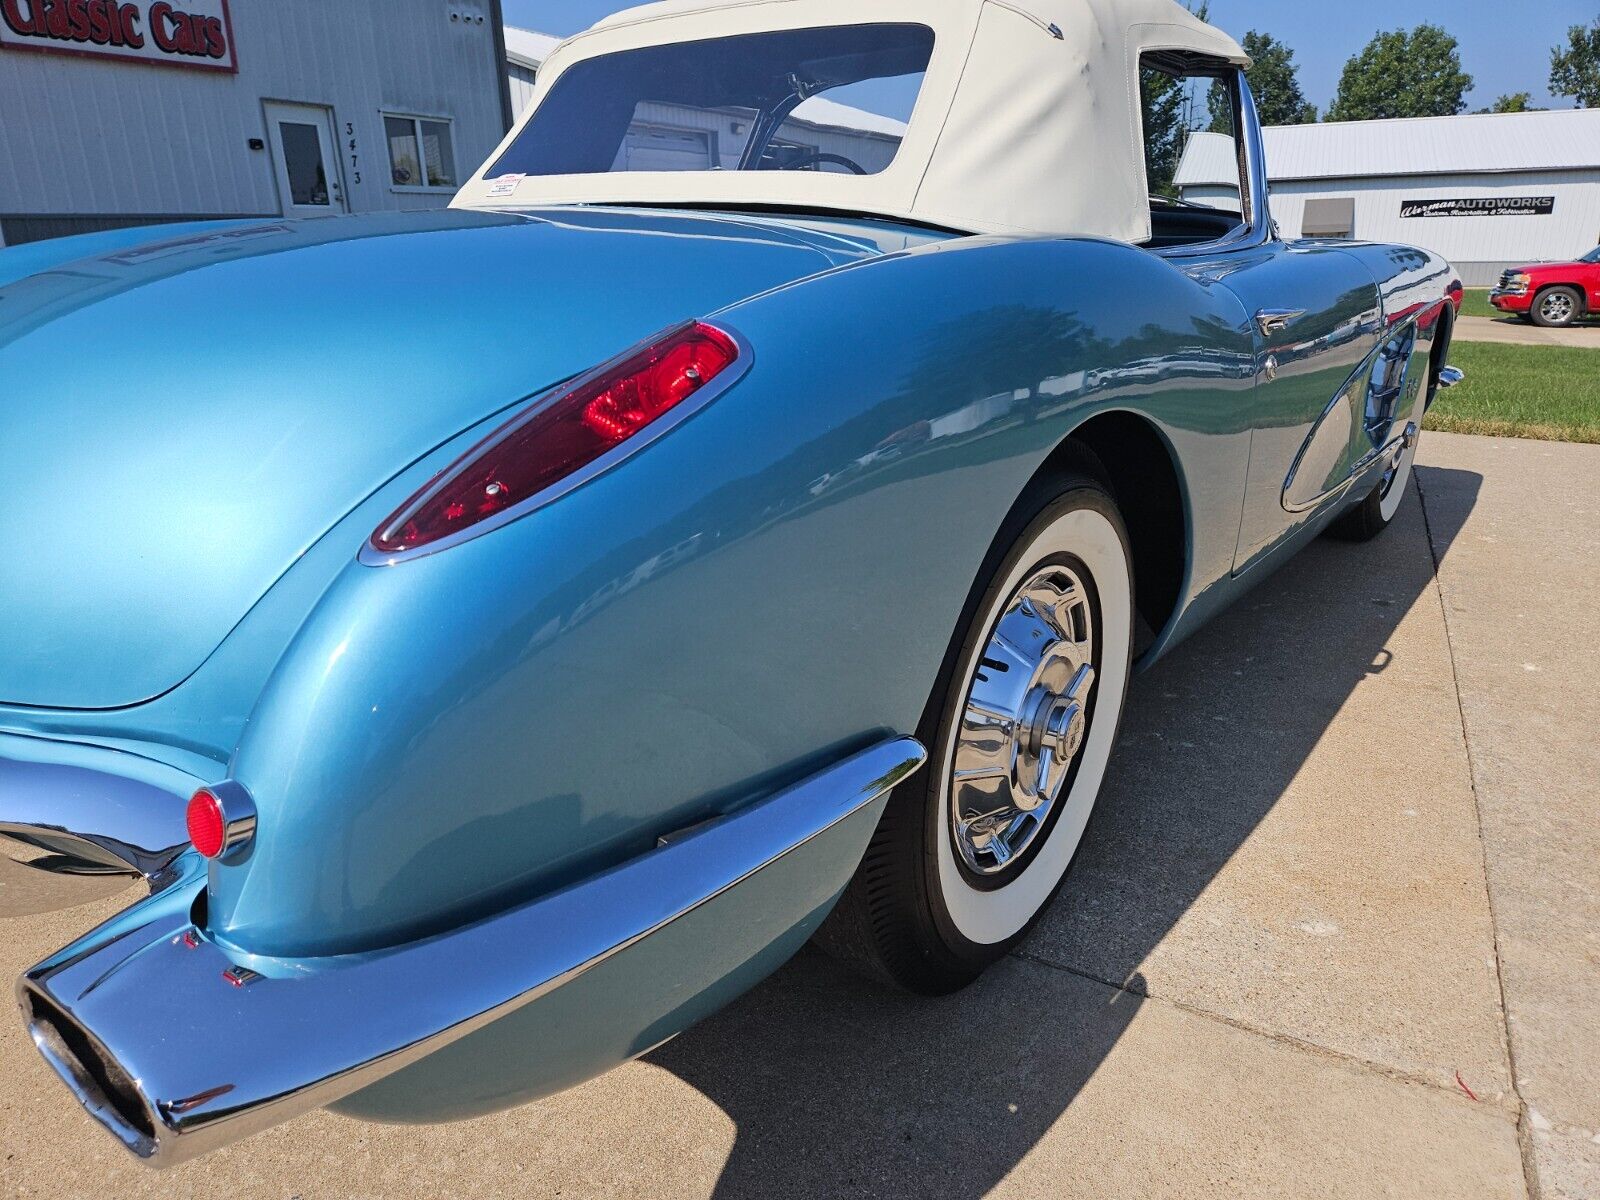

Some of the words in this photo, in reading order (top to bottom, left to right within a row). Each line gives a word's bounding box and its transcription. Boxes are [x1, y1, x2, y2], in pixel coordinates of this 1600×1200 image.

[0, 0, 144, 49] Classic
[149, 1, 226, 59] Cars
[346, 122, 361, 185] 3473
[1456, 198, 1552, 208] AUTOWORKS
